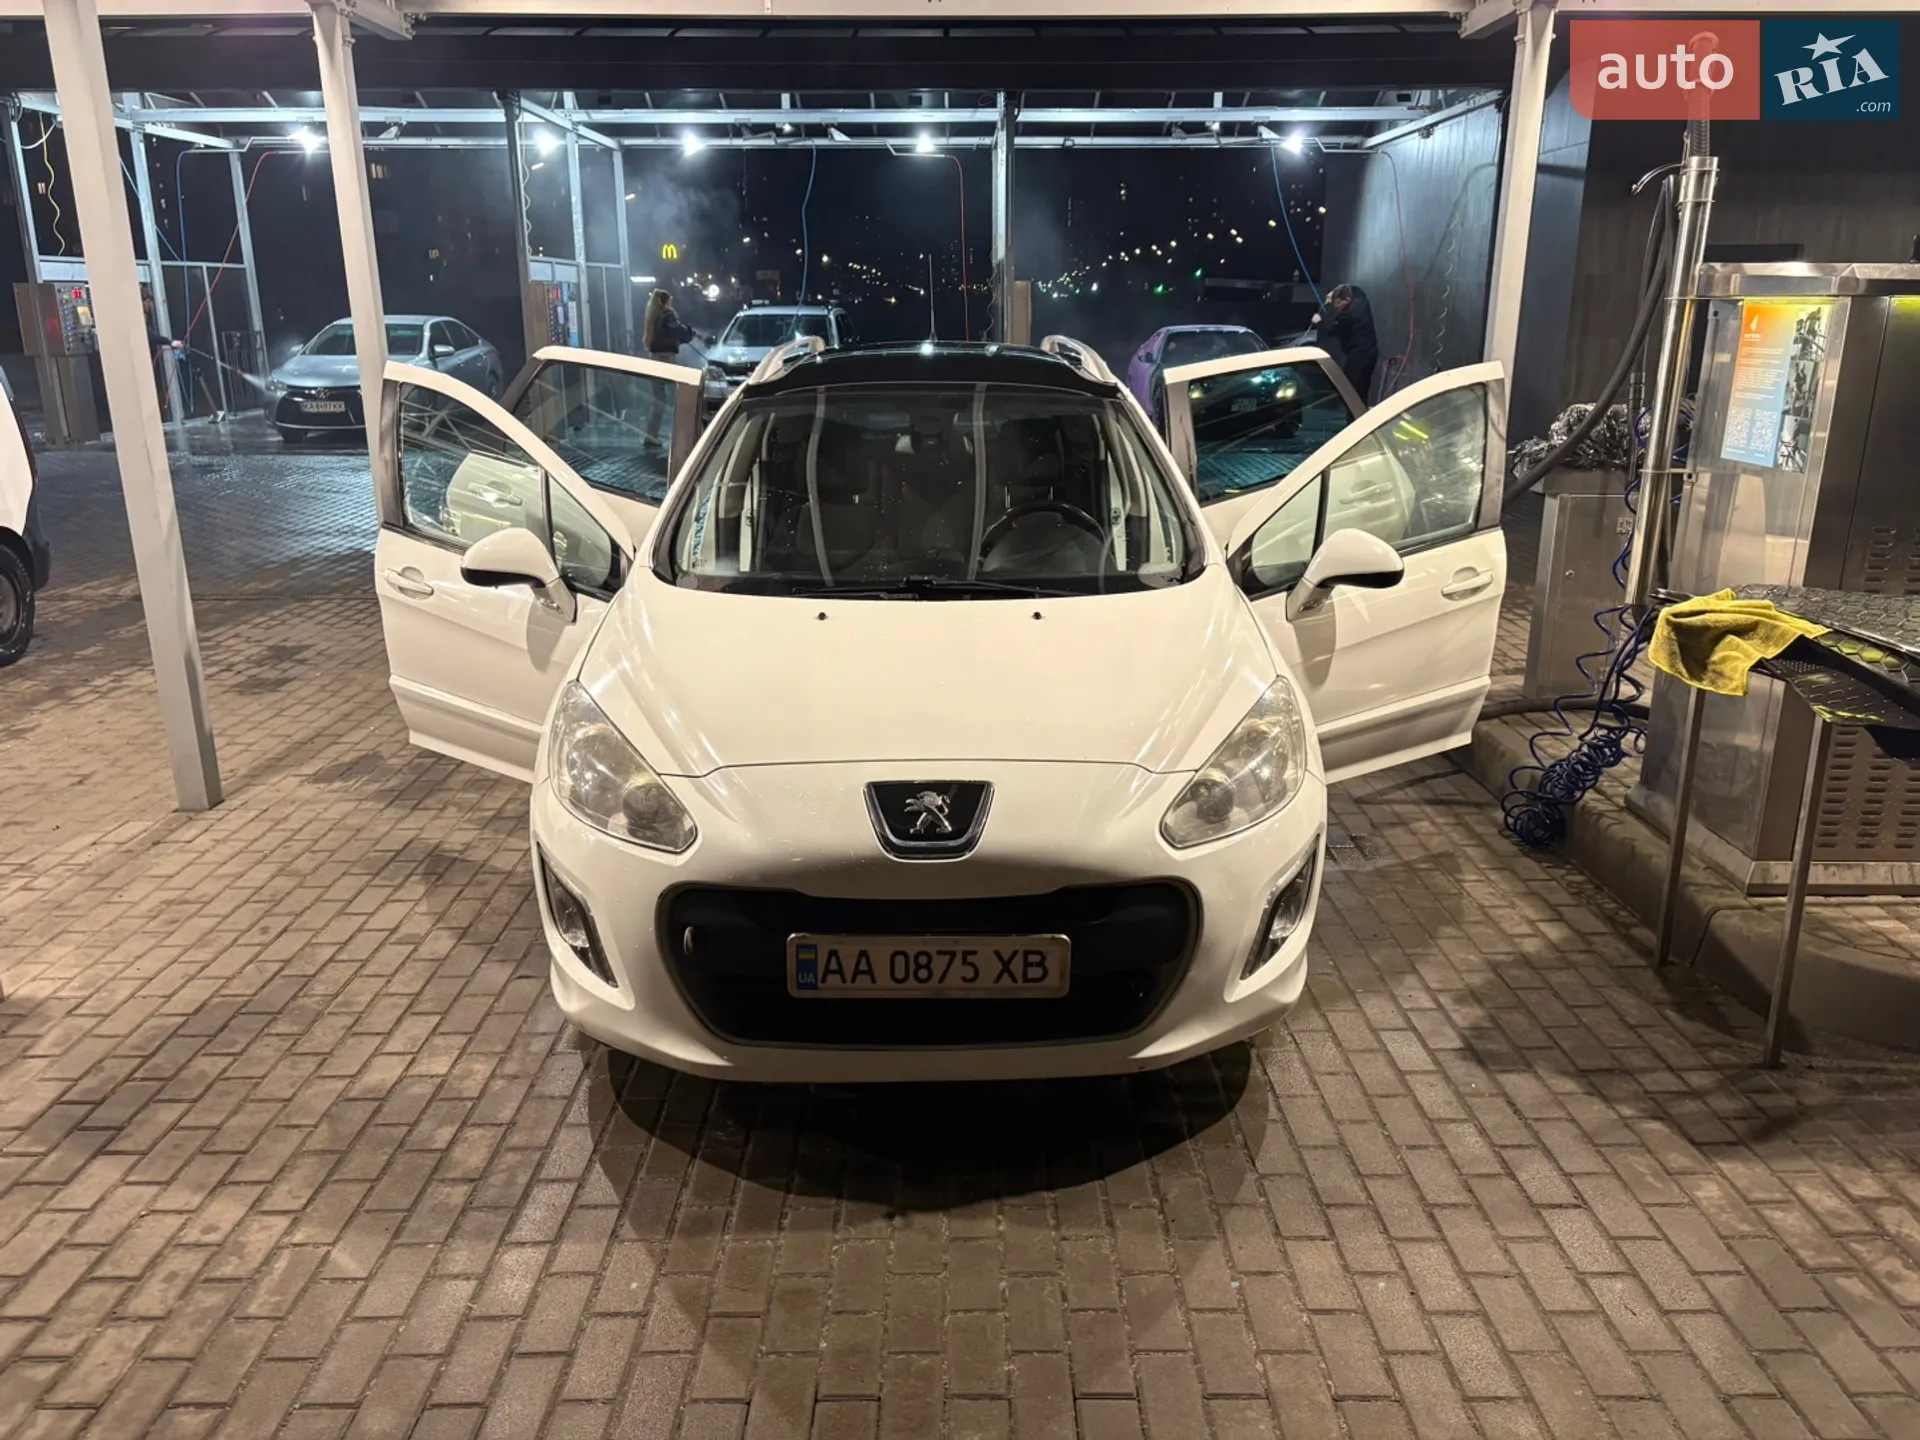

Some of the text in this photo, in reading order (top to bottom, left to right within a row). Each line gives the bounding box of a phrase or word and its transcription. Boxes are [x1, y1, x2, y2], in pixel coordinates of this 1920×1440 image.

[798, 972, 816, 985] UA
[820, 950, 1049, 984] AA 0875 XB
